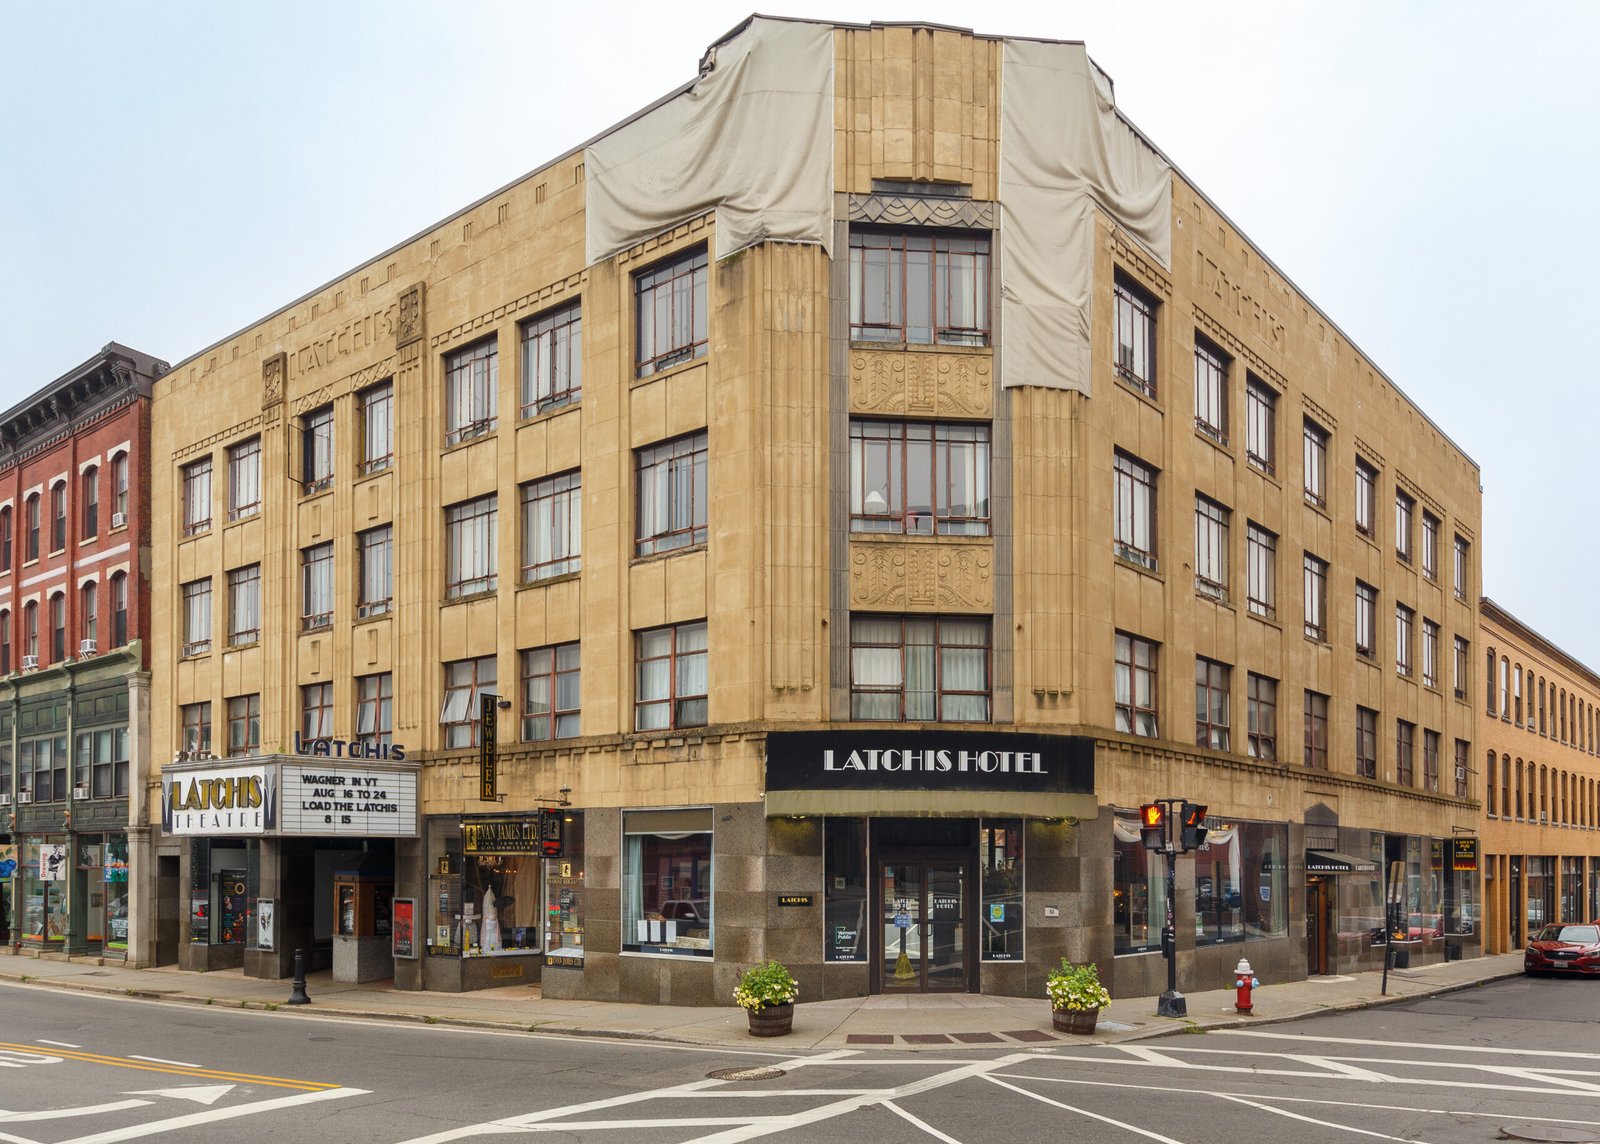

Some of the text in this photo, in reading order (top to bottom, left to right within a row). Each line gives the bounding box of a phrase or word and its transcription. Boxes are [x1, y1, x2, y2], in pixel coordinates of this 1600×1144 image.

[289, 303, 397, 381] LATCHIS
[295, 730, 406, 760] LATCHIS
[484, 699, 494, 797] JEWELER
[823, 748, 1048, 774] LATCHIS HOTEL
[302, 774, 346, 786] WAGNER
[364, 777, 379, 787] VT
[173, 774, 263, 811] LATCHIS
[312, 788, 387, 800] AUG 16 TO 24
[302, 800, 398, 813] LOAD THE LATCHIS
[174, 811, 263, 829] THEATRE
[324, 814, 352, 824] 8 15
[478, 823, 497, 840] EVAN
[498, 823, 521, 840] JAMES
